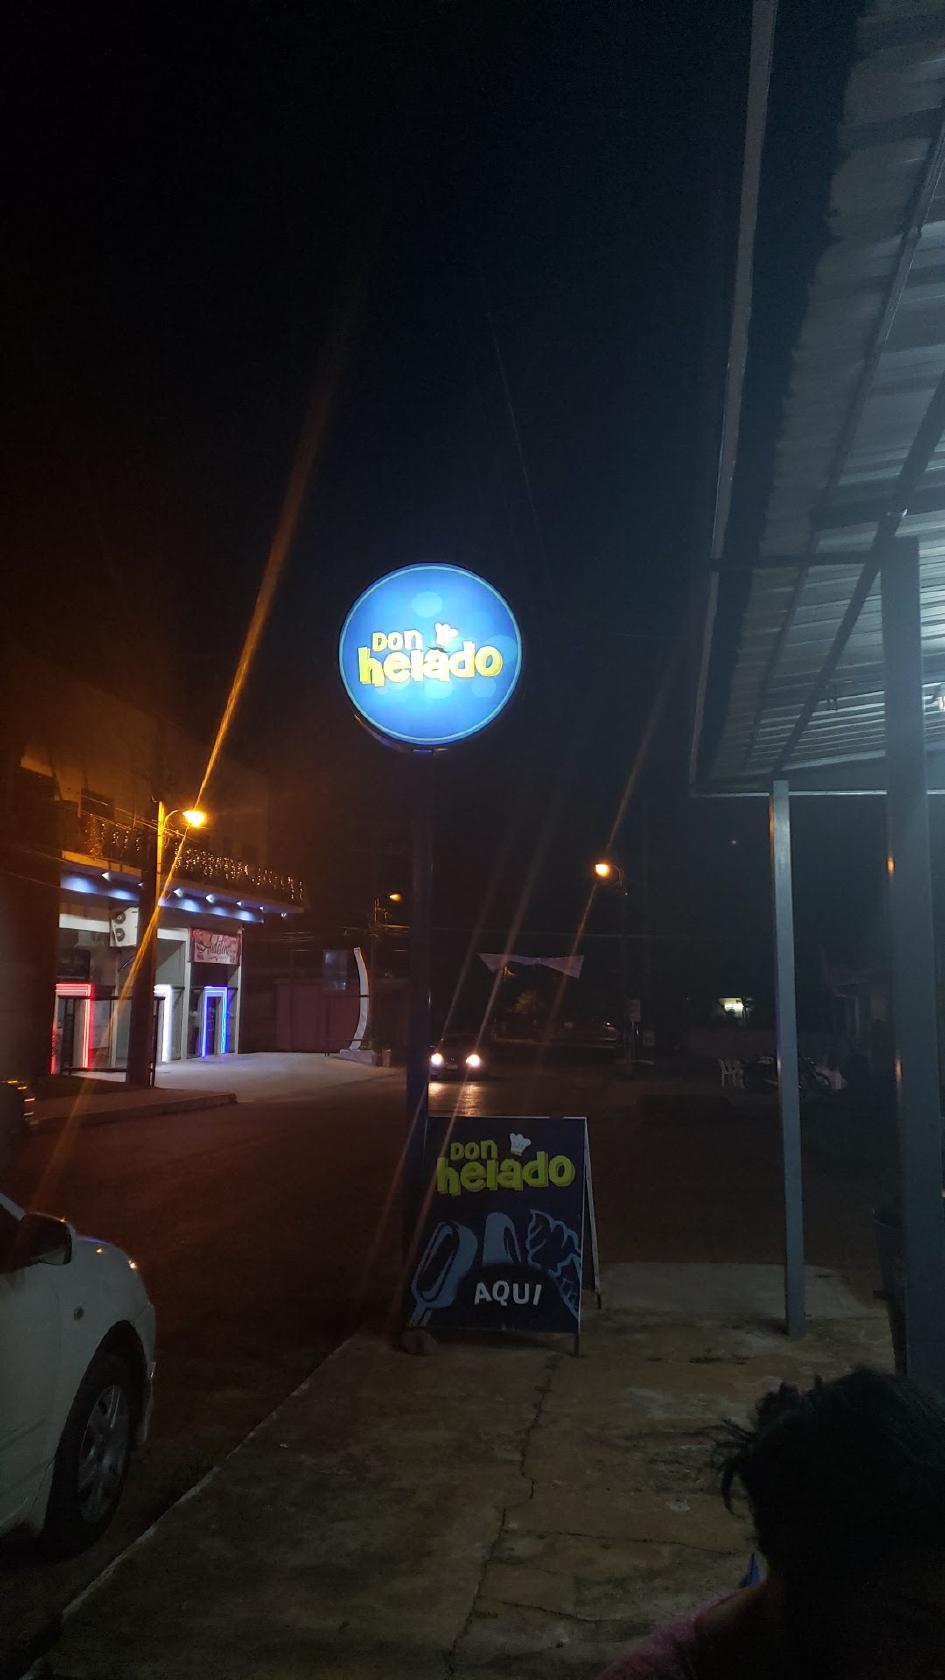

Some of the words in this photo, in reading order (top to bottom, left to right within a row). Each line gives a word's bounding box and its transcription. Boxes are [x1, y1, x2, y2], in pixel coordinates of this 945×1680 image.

[358, 641, 503, 687] helado
[436, 1151, 576, 1197] helado
[474, 1280, 543, 1307] AQUI
